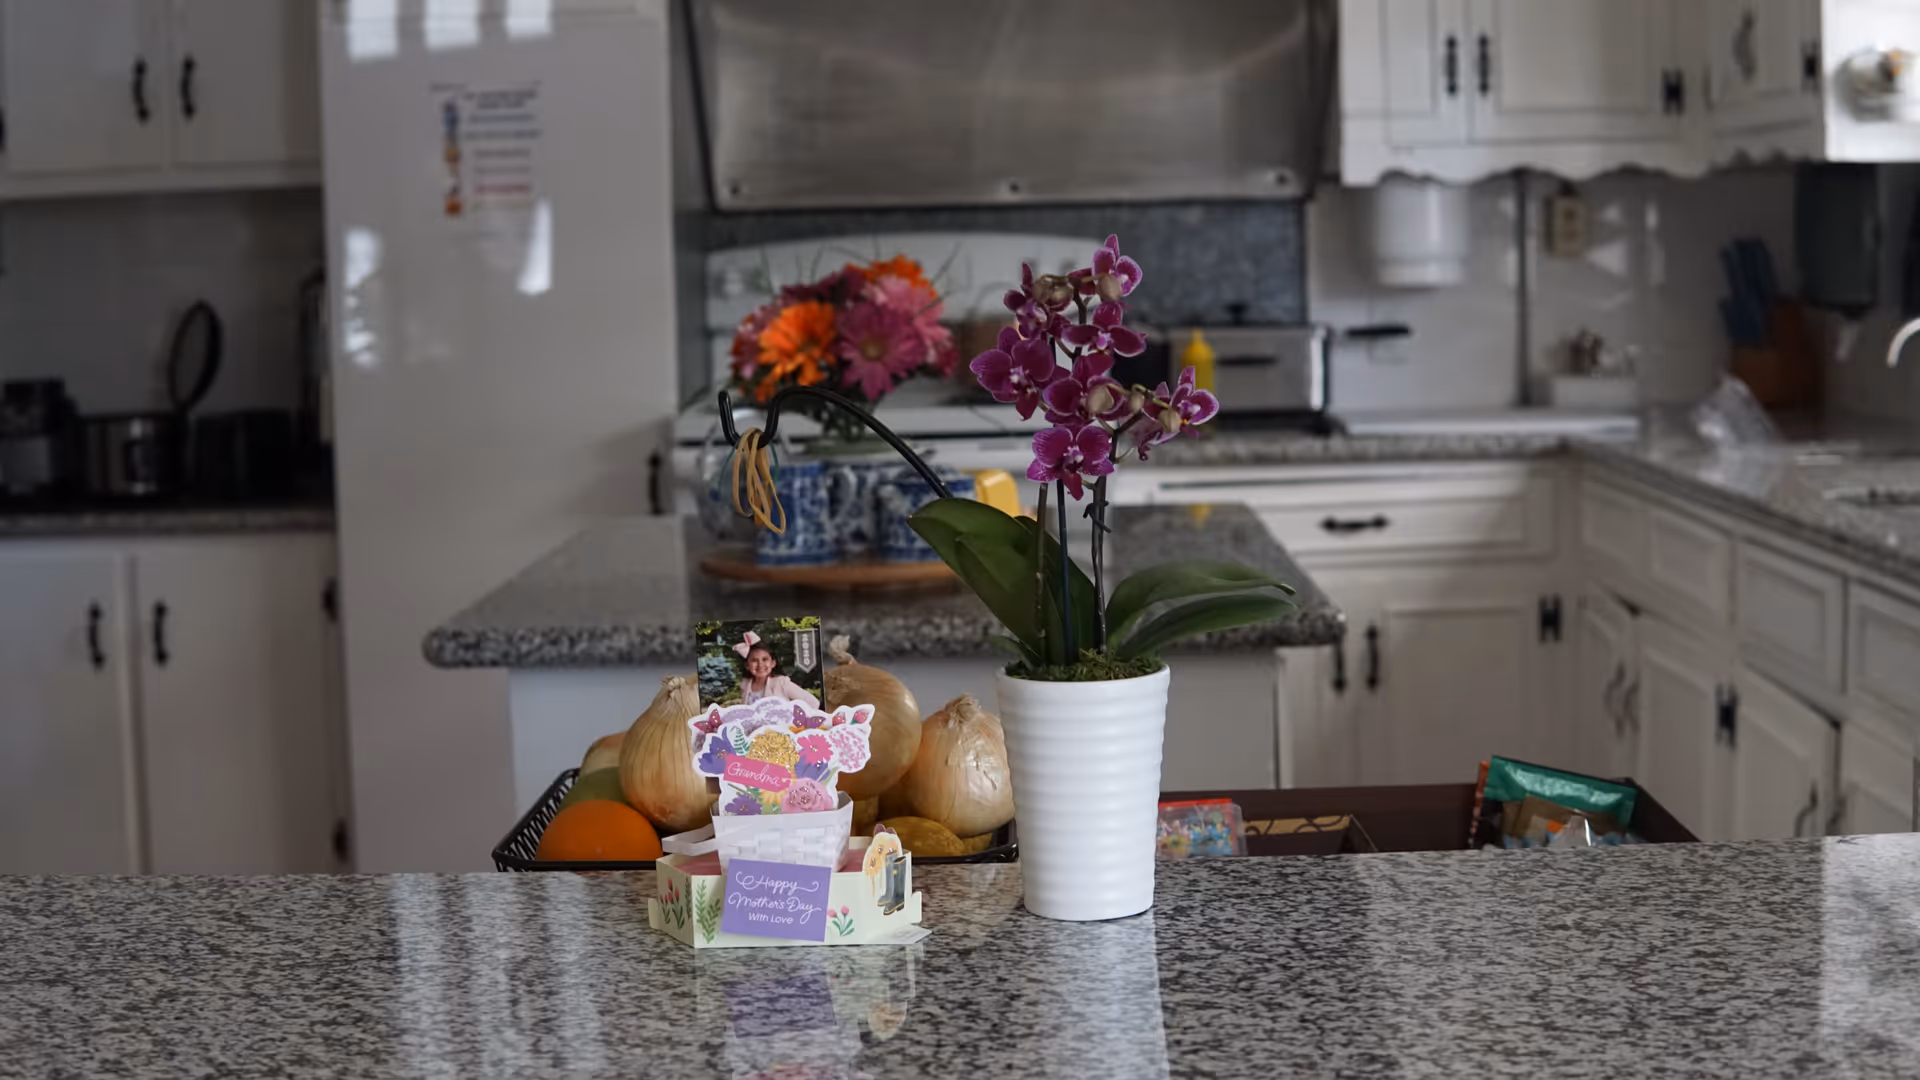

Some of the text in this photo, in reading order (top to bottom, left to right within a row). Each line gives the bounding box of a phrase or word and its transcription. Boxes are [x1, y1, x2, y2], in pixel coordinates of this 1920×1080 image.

[727, 761, 781, 787] Grandma
[735, 871, 820, 896] Happy
[728, 891, 823, 925] Mother's Day
